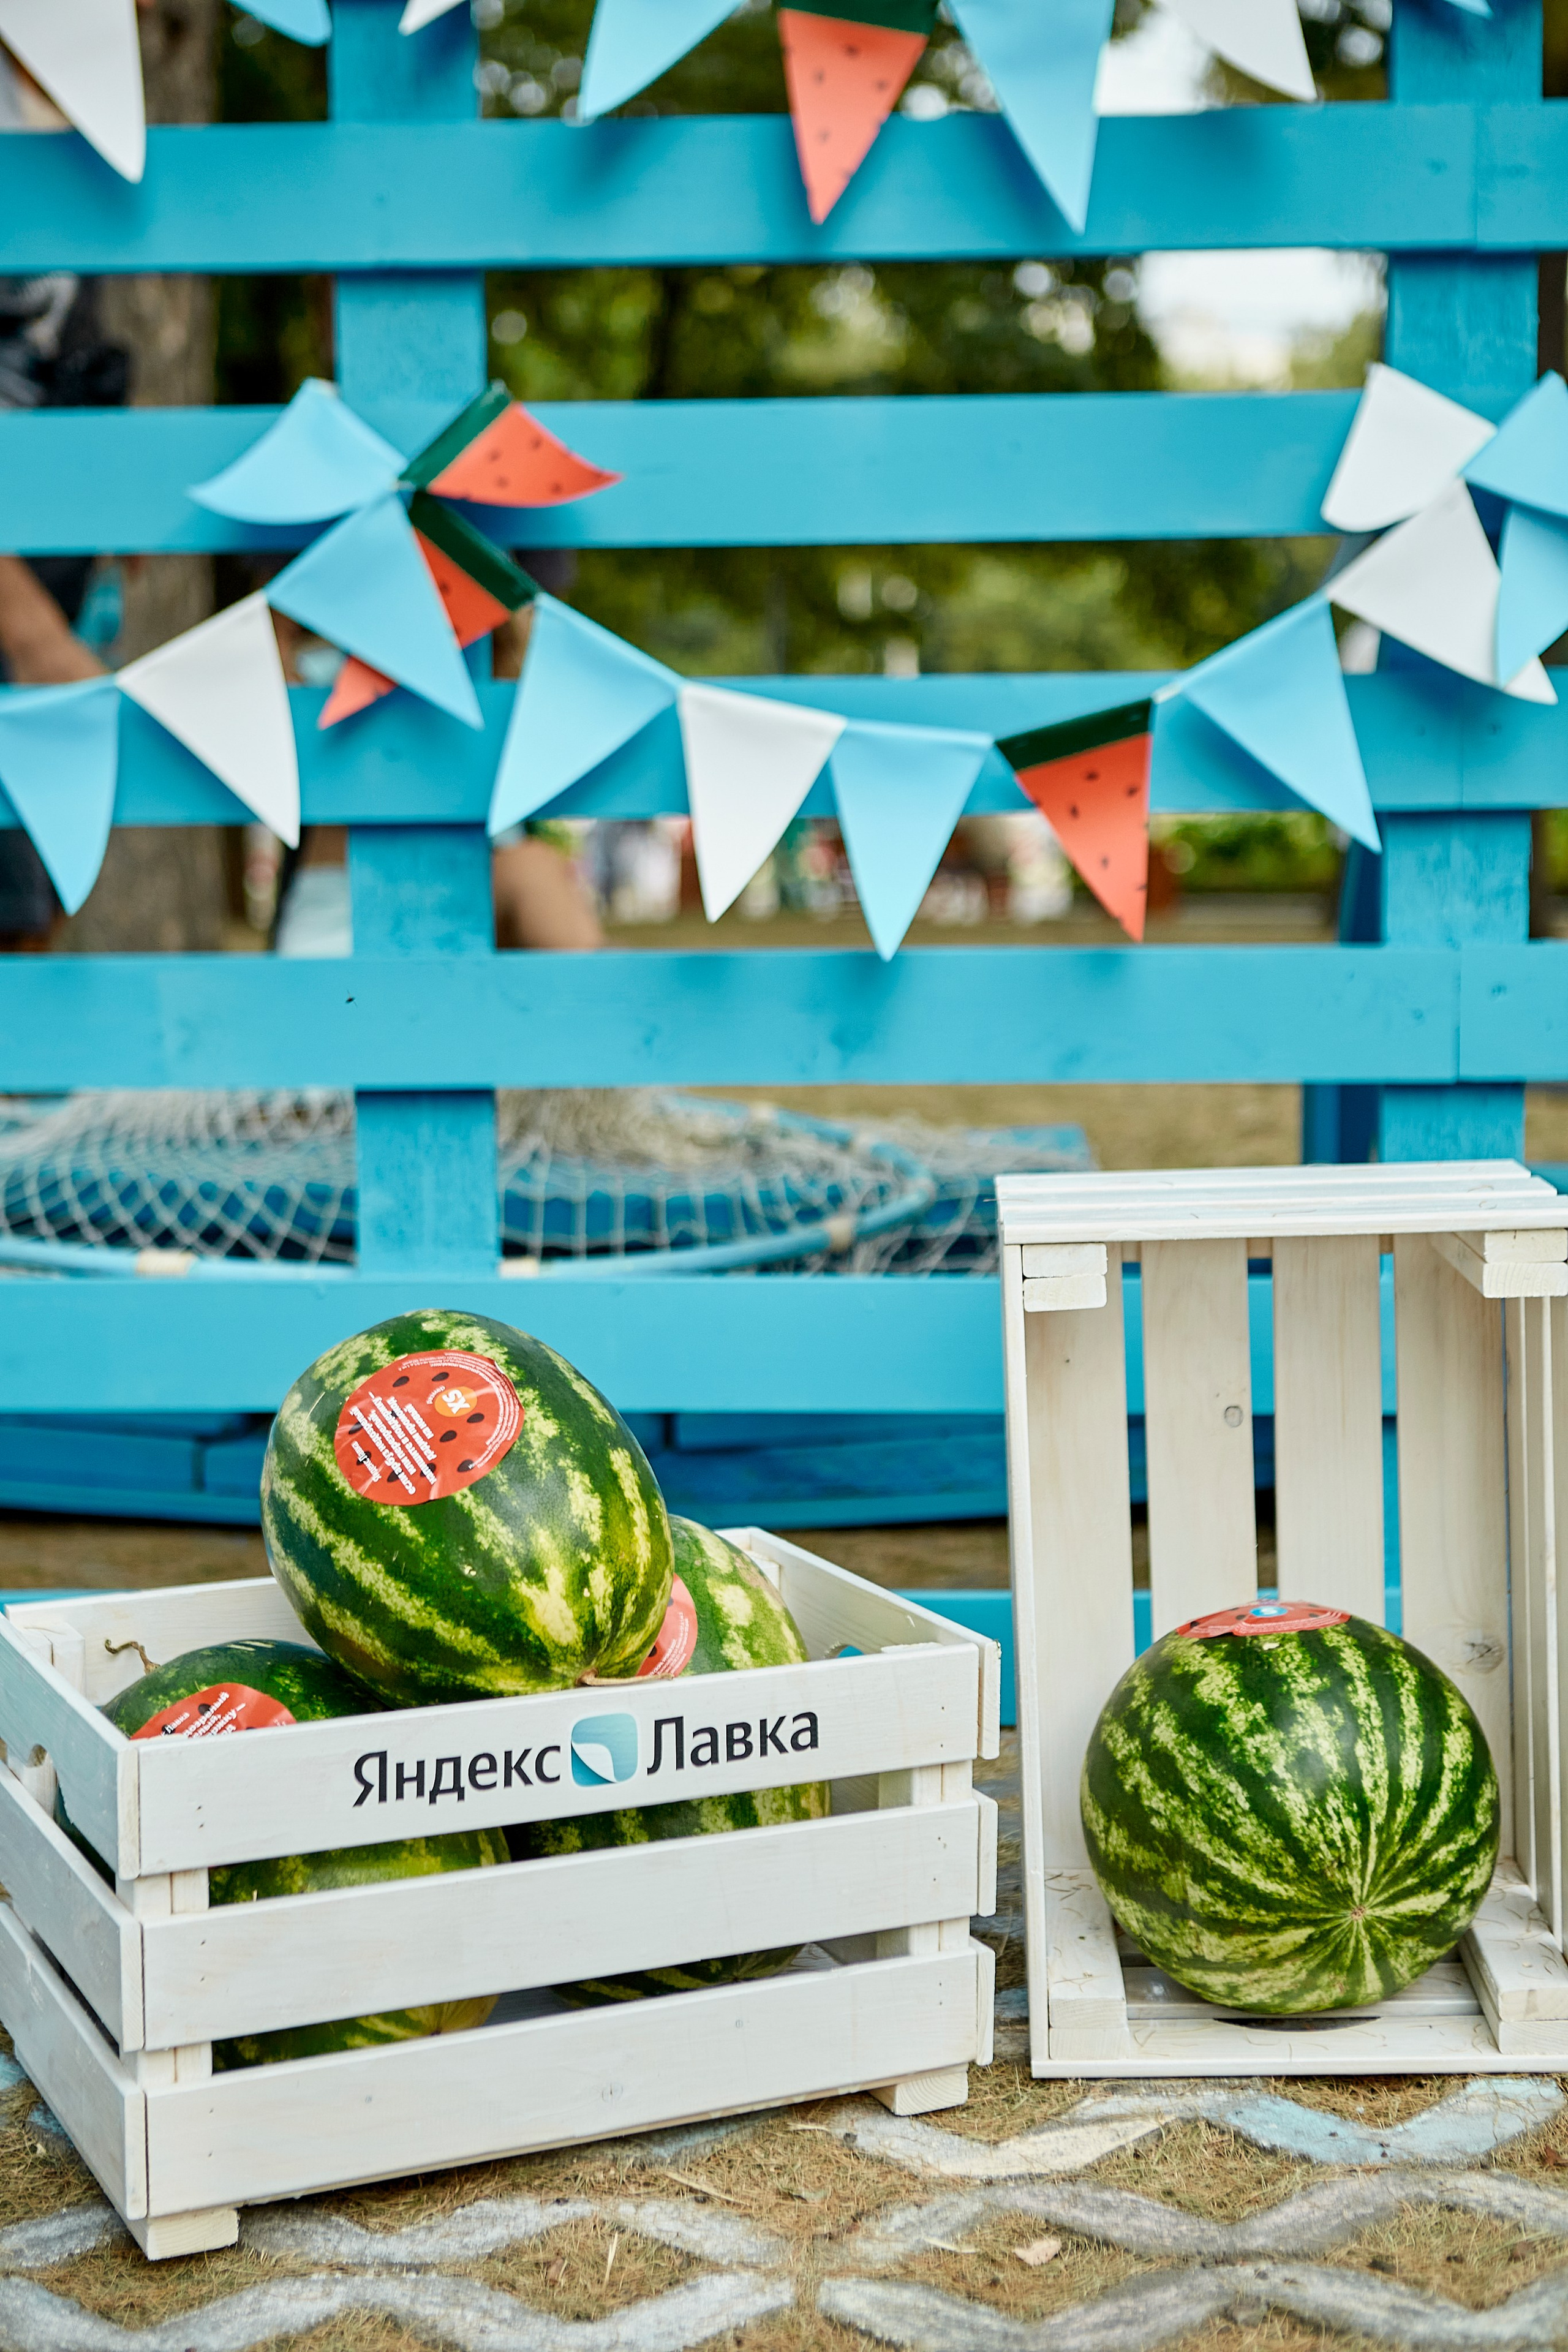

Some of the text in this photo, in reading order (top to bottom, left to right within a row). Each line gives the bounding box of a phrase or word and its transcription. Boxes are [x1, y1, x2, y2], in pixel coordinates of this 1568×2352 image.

[372, 1396, 405, 1439] поддержку
[403, 1403, 434, 1440] на новый
[442, 1389, 470, 1414] XS
[349, 1406, 416, 1494] если арбуз недозрелый
[368, 1409, 417, 1476] или перезрелый,
[386, 1396, 437, 1461] дадим промокод
[401, 1436, 409, 1445] в
[351, 1441, 382, 1482] Яндекс Лавка
[405, 1442, 437, 1485] напишите
[164, 1712, 190, 1734] Лавка
[182, 1692, 230, 1737] дозрелый
[192, 1714, 221, 1738] елый,
[352, 1711, 819, 1809] Яндекс Лавка
